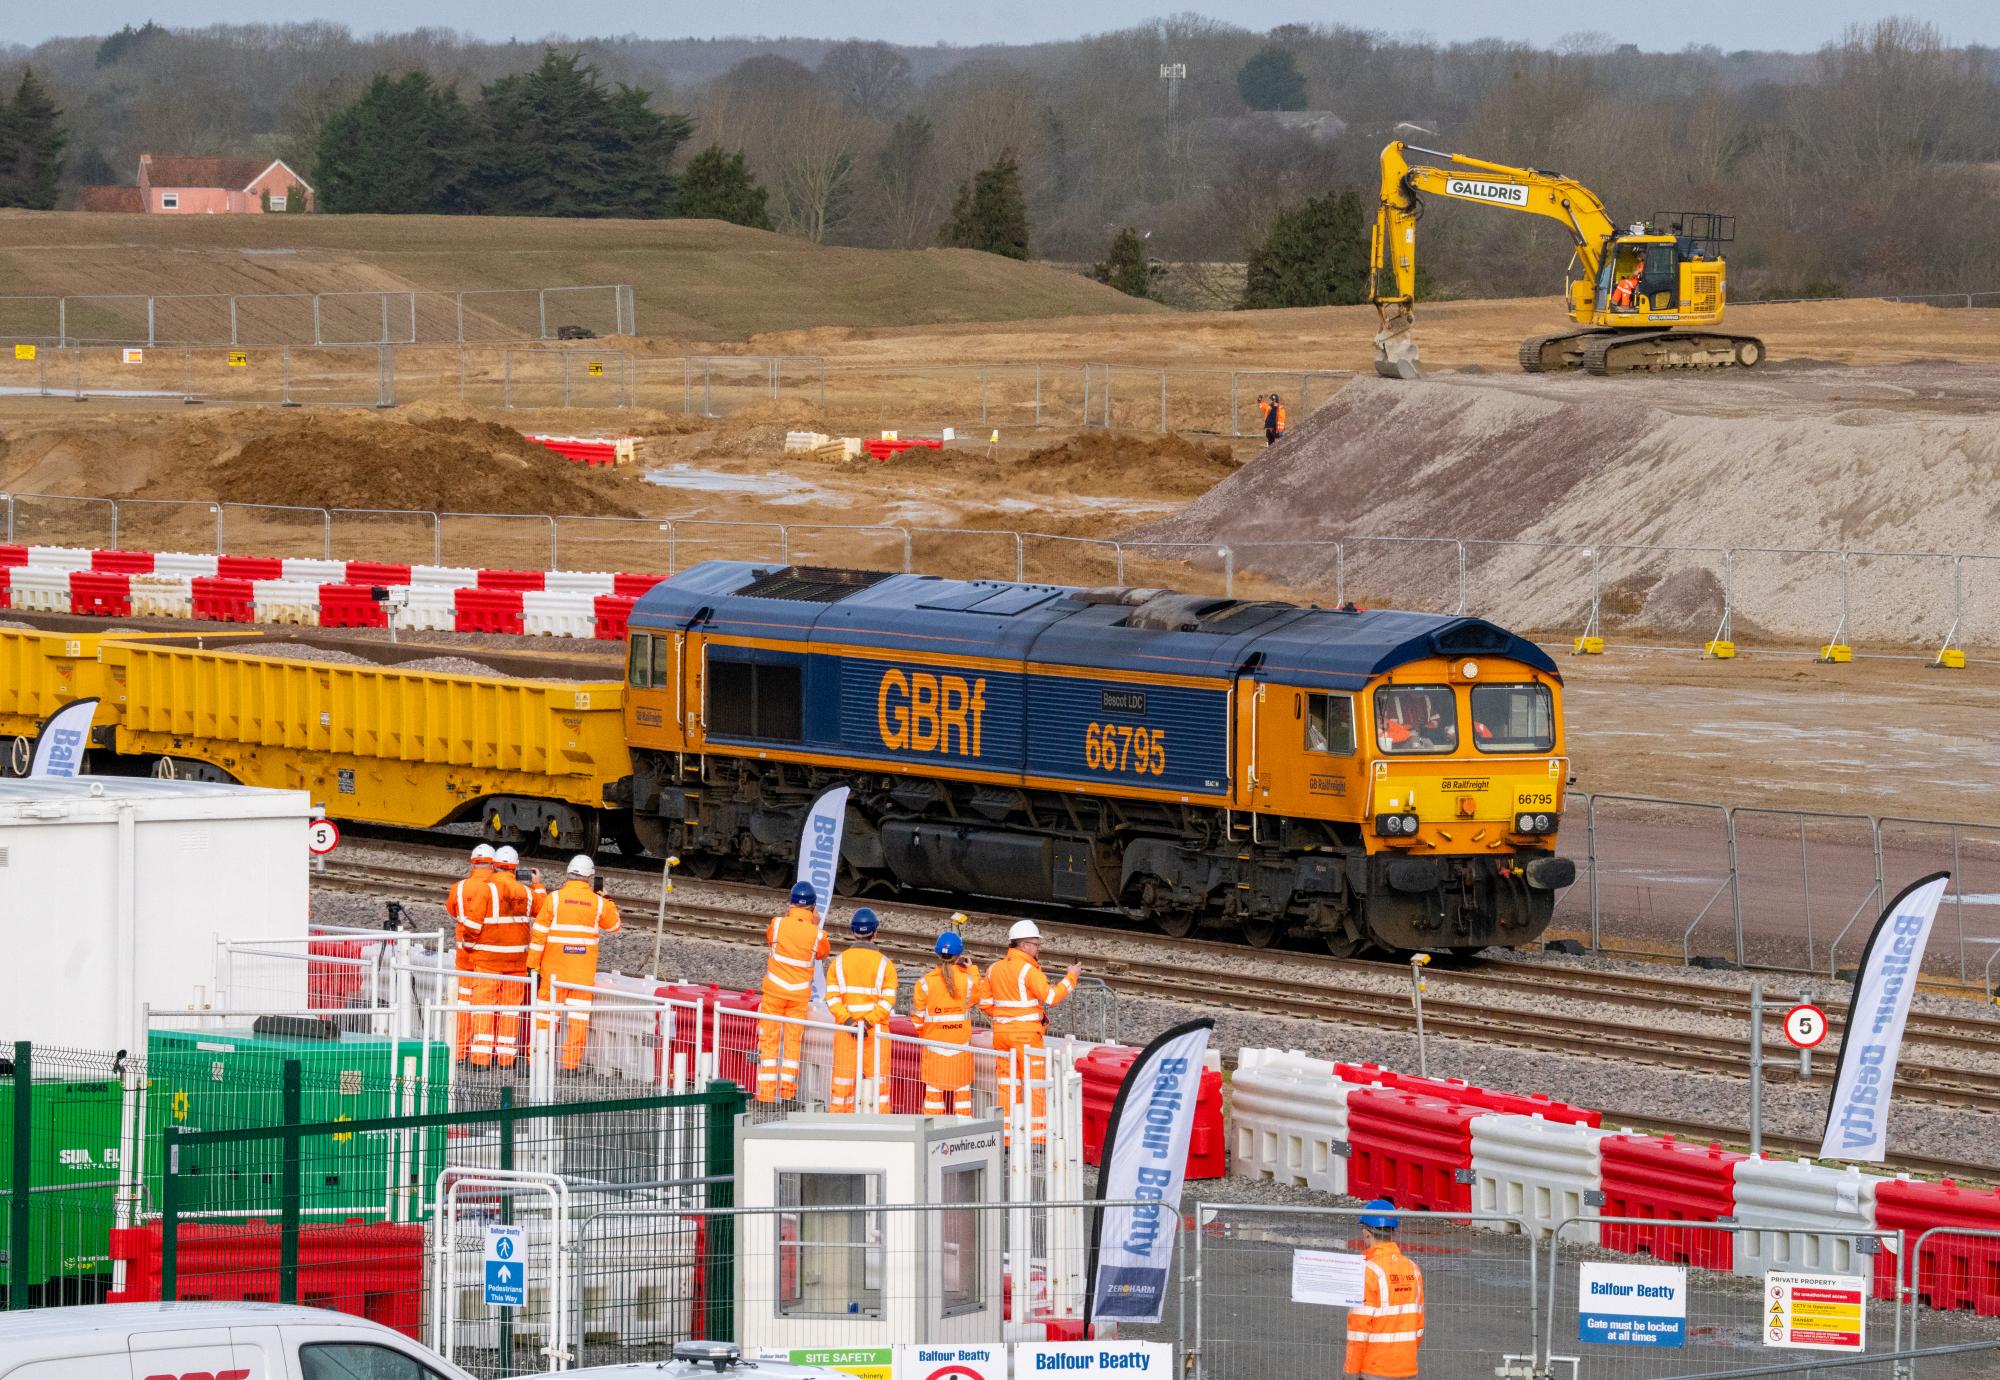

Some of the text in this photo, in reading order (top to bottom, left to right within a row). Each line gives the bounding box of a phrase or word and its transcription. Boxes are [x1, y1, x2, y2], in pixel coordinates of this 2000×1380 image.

[1453, 182, 1522, 201] GALLDRIS
[1103, 693, 1143, 708] Bescot LDC
[878, 668, 986, 758] GBRf
[47, 729, 81, 777] Balf
[1085, 722, 1165, 776] 66795
[1441, 780, 1489, 790] GB Railfreight
[1518, 794, 1552, 804] 66795
[317, 829, 326, 844] 5
[1800, 1017, 1812, 1035] 5
[1142, 1057, 1189, 1159] Balfour
[950, 1135, 996, 1156] pwhire.co.uk
[1123, 1166, 1171, 1257] Beatty
[1771, 1276, 1836, 1286] PRIVATE PROPERTY
[505, 1294, 518, 1303] Way
[1591, 1282, 1675, 1300] Balfour Beatty
[1587, 1318, 1678, 1332] Gate must be locked
[1607, 1331, 1657, 1342] at all times
[806, 1352, 876, 1363] SITE SAFETY
[919, 1350, 990, 1362] Balfour Beatty
[1036, 1351, 1150, 1370] Balfour Beatty
